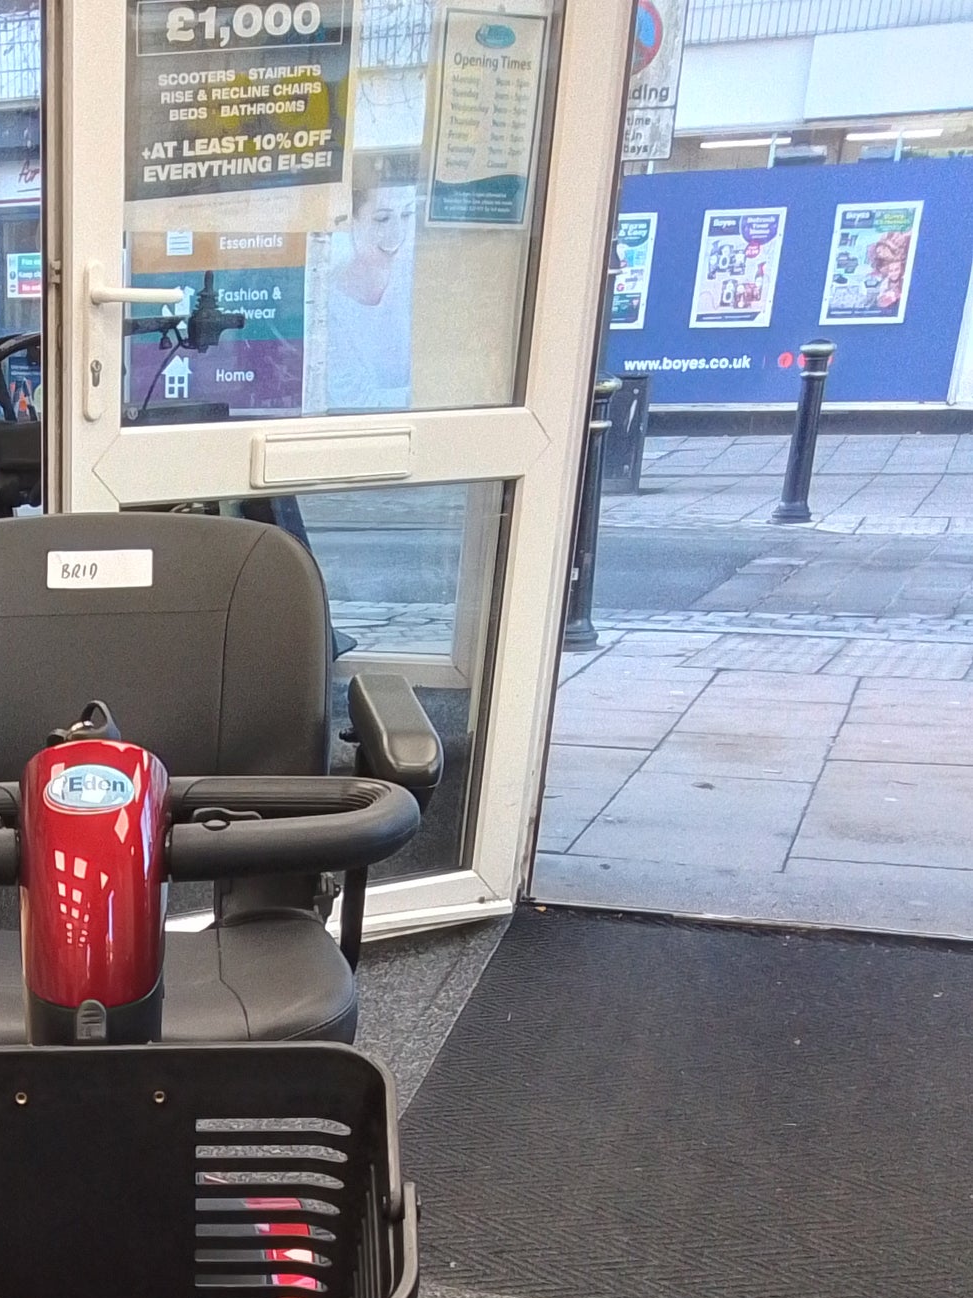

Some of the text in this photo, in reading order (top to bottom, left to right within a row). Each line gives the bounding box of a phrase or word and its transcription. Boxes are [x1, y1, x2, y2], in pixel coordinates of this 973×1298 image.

[166, 2, 321, 47] £1,000
[454, 52, 532, 72] Opening Times
[158, 64, 321, 87] SCOOTERS STAIRLIFTS
[160, 82, 322, 104] RISE & RECLINE CHAIRS
[169, 100, 305, 121] BEDS BATHROOMS
[141, 129, 332, 160] +AT LEAST 10% OFF
[143, 151, 332, 183] EVERYTHING ELSE!
[220, 234, 284, 250] Essentials
[218, 286, 281, 302] Fashion &
[624, 355, 751, 372] www.boyes.co.uk
[216, 369, 254, 382] Home
[69, 775, 125, 793] Eden
